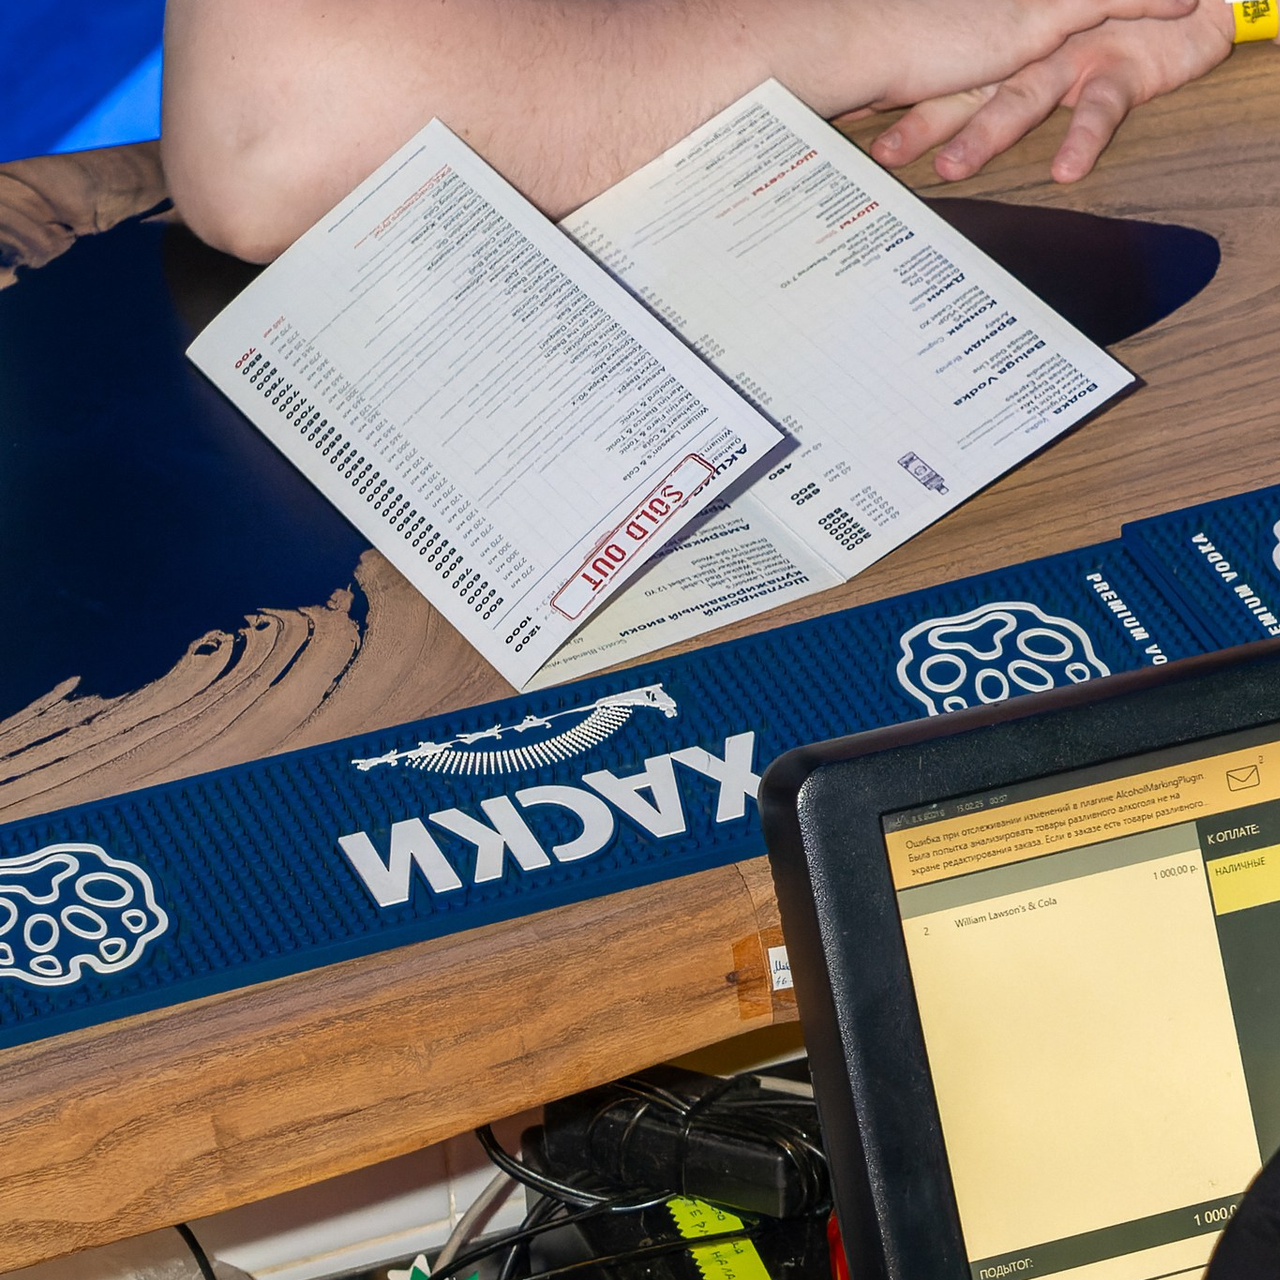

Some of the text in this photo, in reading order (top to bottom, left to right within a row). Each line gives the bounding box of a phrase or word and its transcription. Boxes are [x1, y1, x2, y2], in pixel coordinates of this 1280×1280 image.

[837, 200, 880, 231] Шоты
[883, 229, 915, 253] Ром
[923, 271, 967, 303] Джин
[944, 298, 998, 337] Коньяк
[961, 315, 1018, 356] Бренди
[952, 339, 1047, 408] Beluga Vodka
[618, 374, 676, 426] Bosford Tonic
[656, 382, 684, 409] Martini
[1050, 381, 1098, 416] Водка
[617, 389, 692, 456] Martini Fiero Tonic
[641, 396, 700, 451] Oakheart Cola
[604, 433, 626, 454] Tonic
[621, 404, 709, 483] William Lawson's Cola
[334, 448, 359, 472] 650
[341, 455, 367, 479] 650
[348, 462, 374, 487] 600
[356, 470, 382, 495] 600
[363, 478, 389, 503] 600
[371, 485, 397, 510] 600
[379, 492, 405, 518] 600
[386, 500, 412, 525] 600
[816, 505, 842, 526] 550
[393, 508, 418, 532] 550
[401, 515, 427, 540] 500
[827, 515, 855, 536] 400
[833, 520, 861, 541] 300
[409, 523, 434, 548] 500
[416, 531, 442, 556] 500
[577, 481, 686, 591] SOLD OUT
[839, 525, 866, 546] 300
[845, 530, 872, 551] 300
[424, 538, 450, 563] 500
[432, 546, 458, 571] 500
[1191, 533, 1238, 582] VODKA
[439, 554, 465, 579] 500
[449, 566, 473, 590] 750
[456, 572, 482, 597] 600
[464, 580, 490, 605] 600
[701, 573, 810, 617] Шотландский
[472, 588, 498, 613] 600
[479, 596, 505, 621] 500
[618, 567, 803, 638] купажированный виски
[1087, 573, 1150, 641] PREMIUM
[502, 614, 534, 645] 1000
[511, 622, 543, 653] 1200
[338, 731, 763, 907] ХАСКИ
[905, 836, 941, 850] Ошибка
[942, 832, 960, 843] при
[961, 817, 1021, 838] отслеживании
[1023, 803, 1071, 821] изменений
[1080, 793, 1114, 809] плагине
[908, 793, 1180, 862] Была попытка анализировать товары разливного алкоголя не на
[910, 862, 940, 876] экране
[942, 846, 1012, 869] редактирования
[1045, 831, 1064, 844] Если
[1074, 824, 1102, 838] заказе
[1104, 819, 1121, 829] есть
[1122, 813, 1154, 827] товары
[1207, 824, 1260, 844] К ОПЛАТЕ:
[1215, 857, 1265, 876] НАЛИЧНЫЕ
[923, 897, 1057, 936] 2 William Lawson's & Cola
[980, 1257, 1034, 1280] ПОДЫТОГ:
